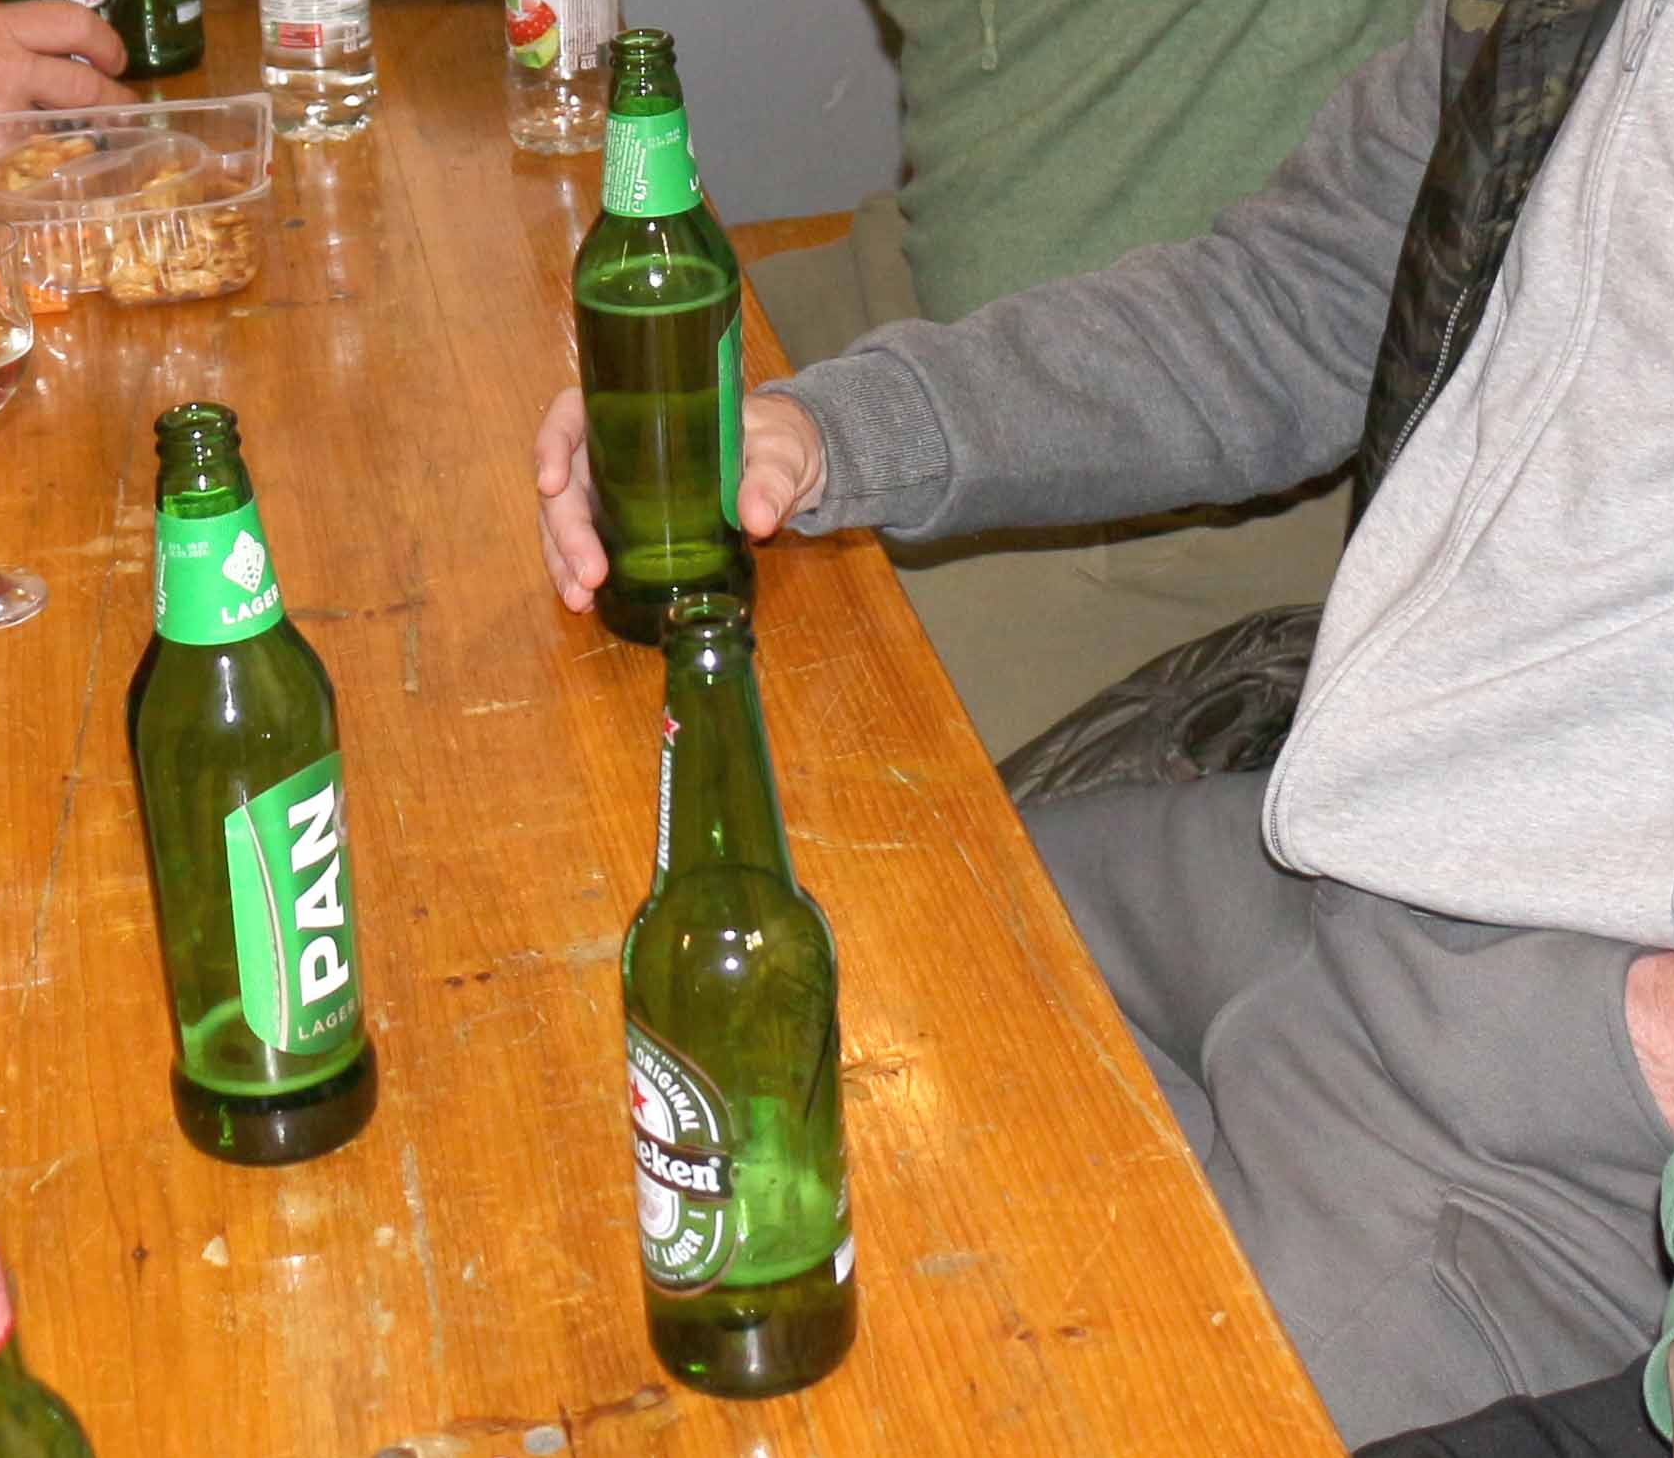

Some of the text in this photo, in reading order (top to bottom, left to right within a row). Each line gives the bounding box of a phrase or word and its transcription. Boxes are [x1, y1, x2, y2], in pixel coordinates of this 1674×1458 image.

[221, 583, 280, 625] LAGER
[288, 781, 350, 1007] PAN
[298, 997, 358, 1041] LAGER
[635, 1046, 701, 1133] ORIGINAL
